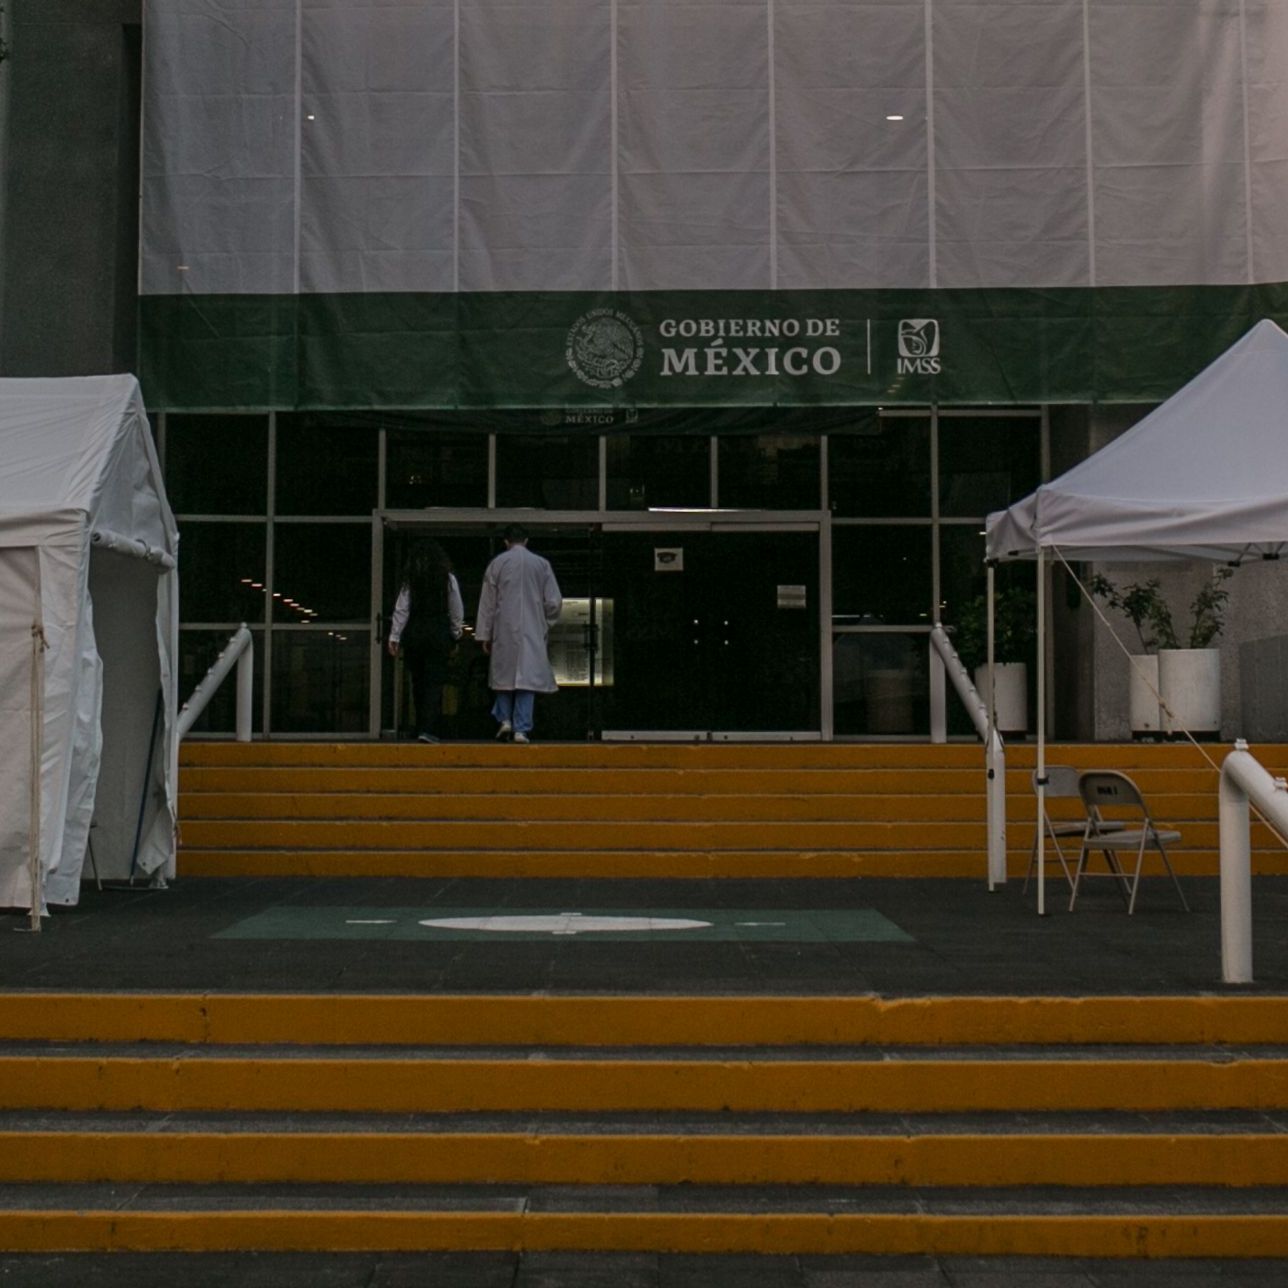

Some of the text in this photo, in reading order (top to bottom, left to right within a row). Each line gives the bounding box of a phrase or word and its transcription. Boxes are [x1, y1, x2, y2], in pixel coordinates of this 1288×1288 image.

[659, 318, 840, 337] GOBIERNO DE
[659, 338, 842, 376] MÉXICO
[897, 357, 941, 374] IMSS
